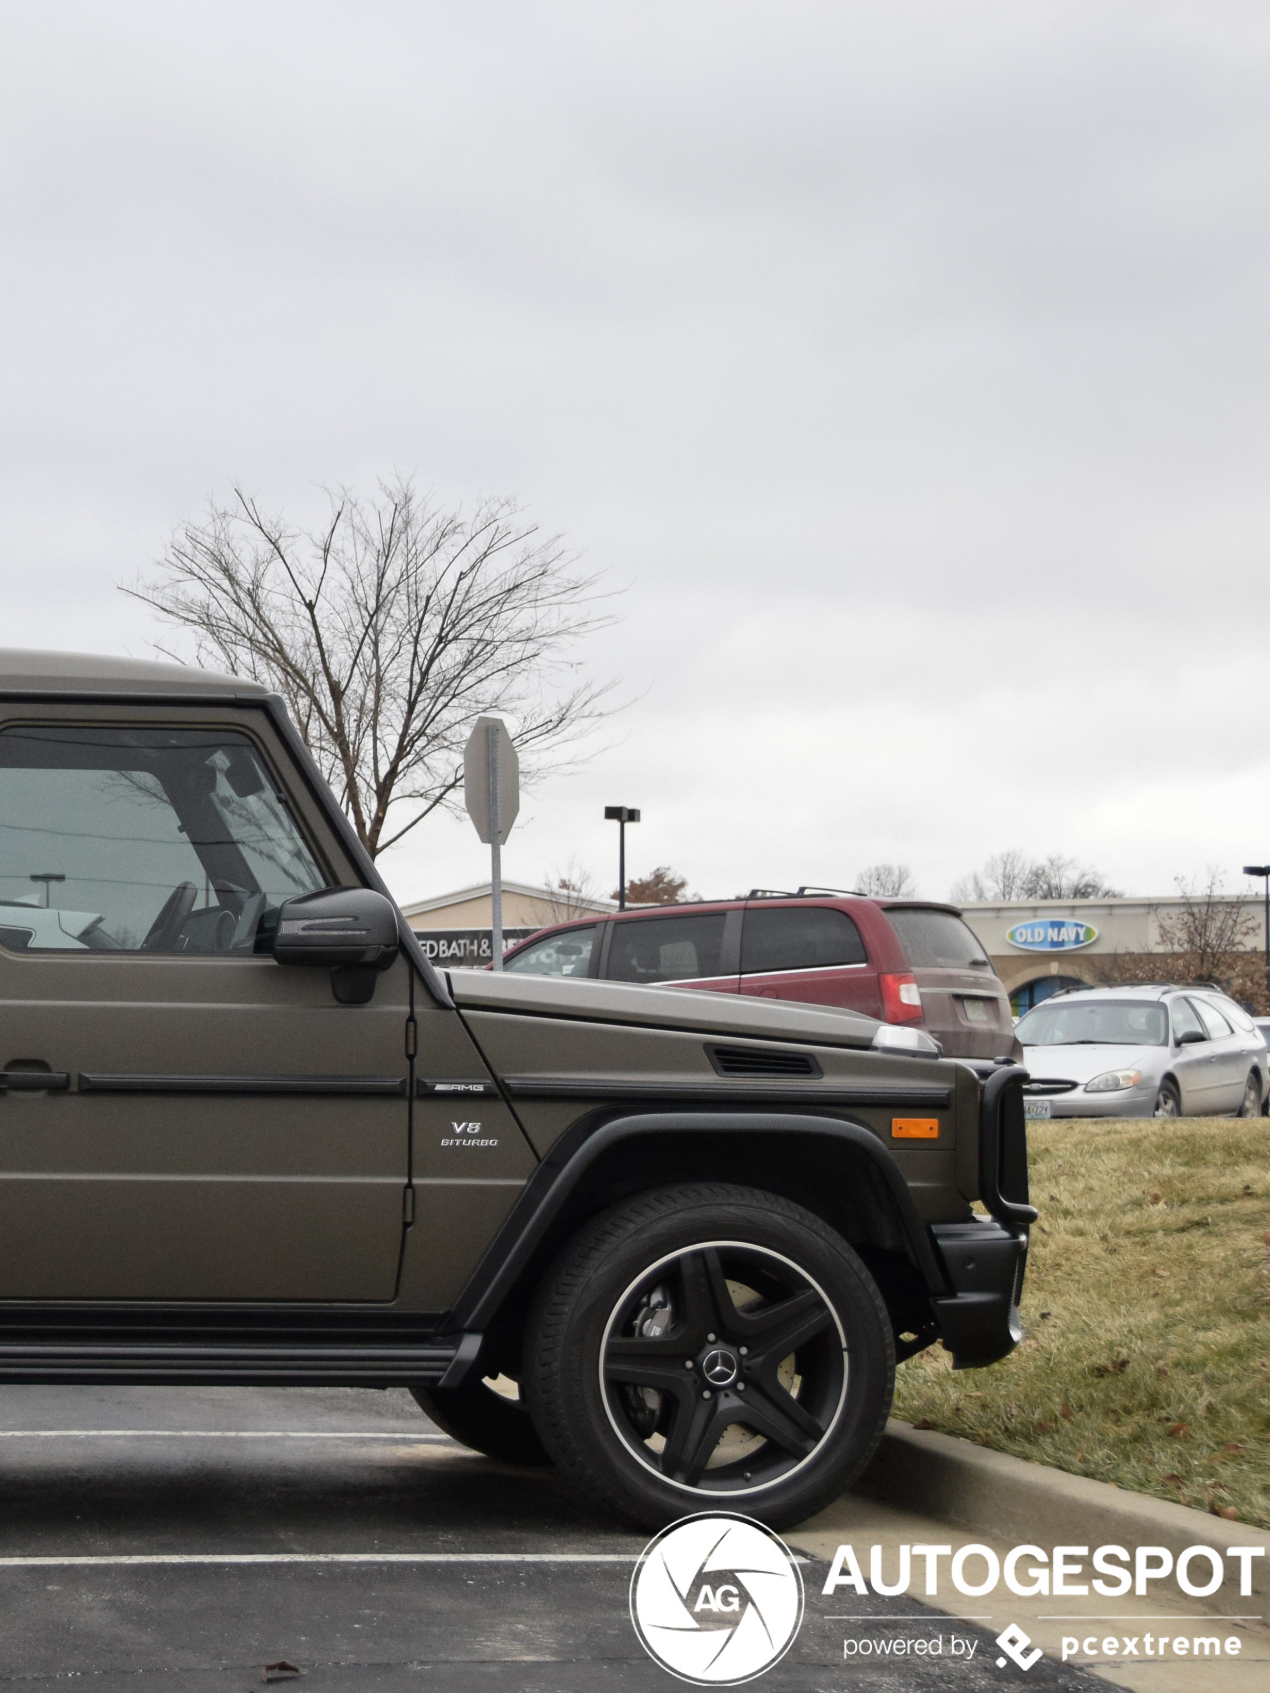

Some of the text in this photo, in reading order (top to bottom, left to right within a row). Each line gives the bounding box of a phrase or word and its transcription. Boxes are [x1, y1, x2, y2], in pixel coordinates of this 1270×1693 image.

[1016, 927, 1087, 943] OLD NAVY
[419, 940, 438, 958] ED
[438, 939, 478, 958] BATH
[479, 938, 492, 957] &
[451, 1121, 481, 1134] V8
[440, 1138, 499, 1147] BITURBO
